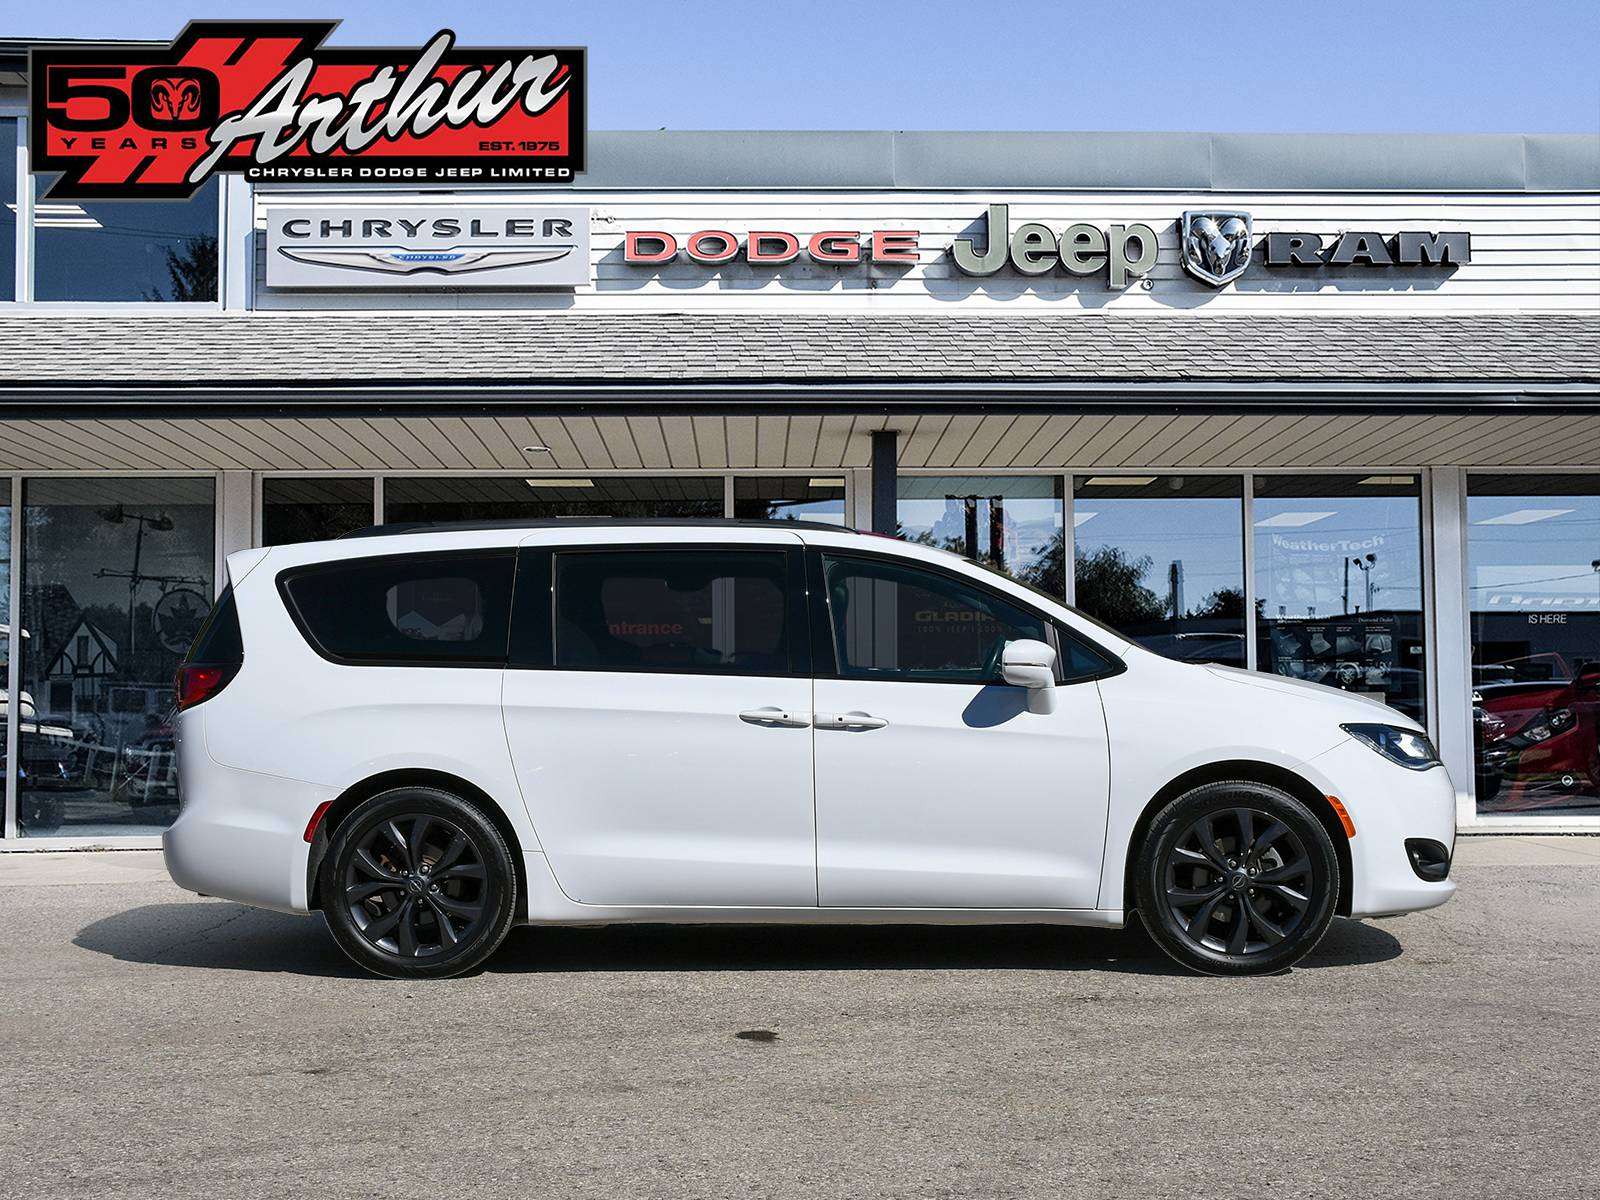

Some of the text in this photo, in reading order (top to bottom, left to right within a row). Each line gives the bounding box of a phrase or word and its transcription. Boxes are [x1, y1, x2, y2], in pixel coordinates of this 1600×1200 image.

[281, 218, 574, 239] CHRYSLER
[624, 230, 921, 266] DODGE
[952, 204, 1160, 289] Jeep
[1265, 231, 1471, 267] RAM
[607, 620, 683, 635] ntrance
[1527, 614, 1567, 624] IS HERE
